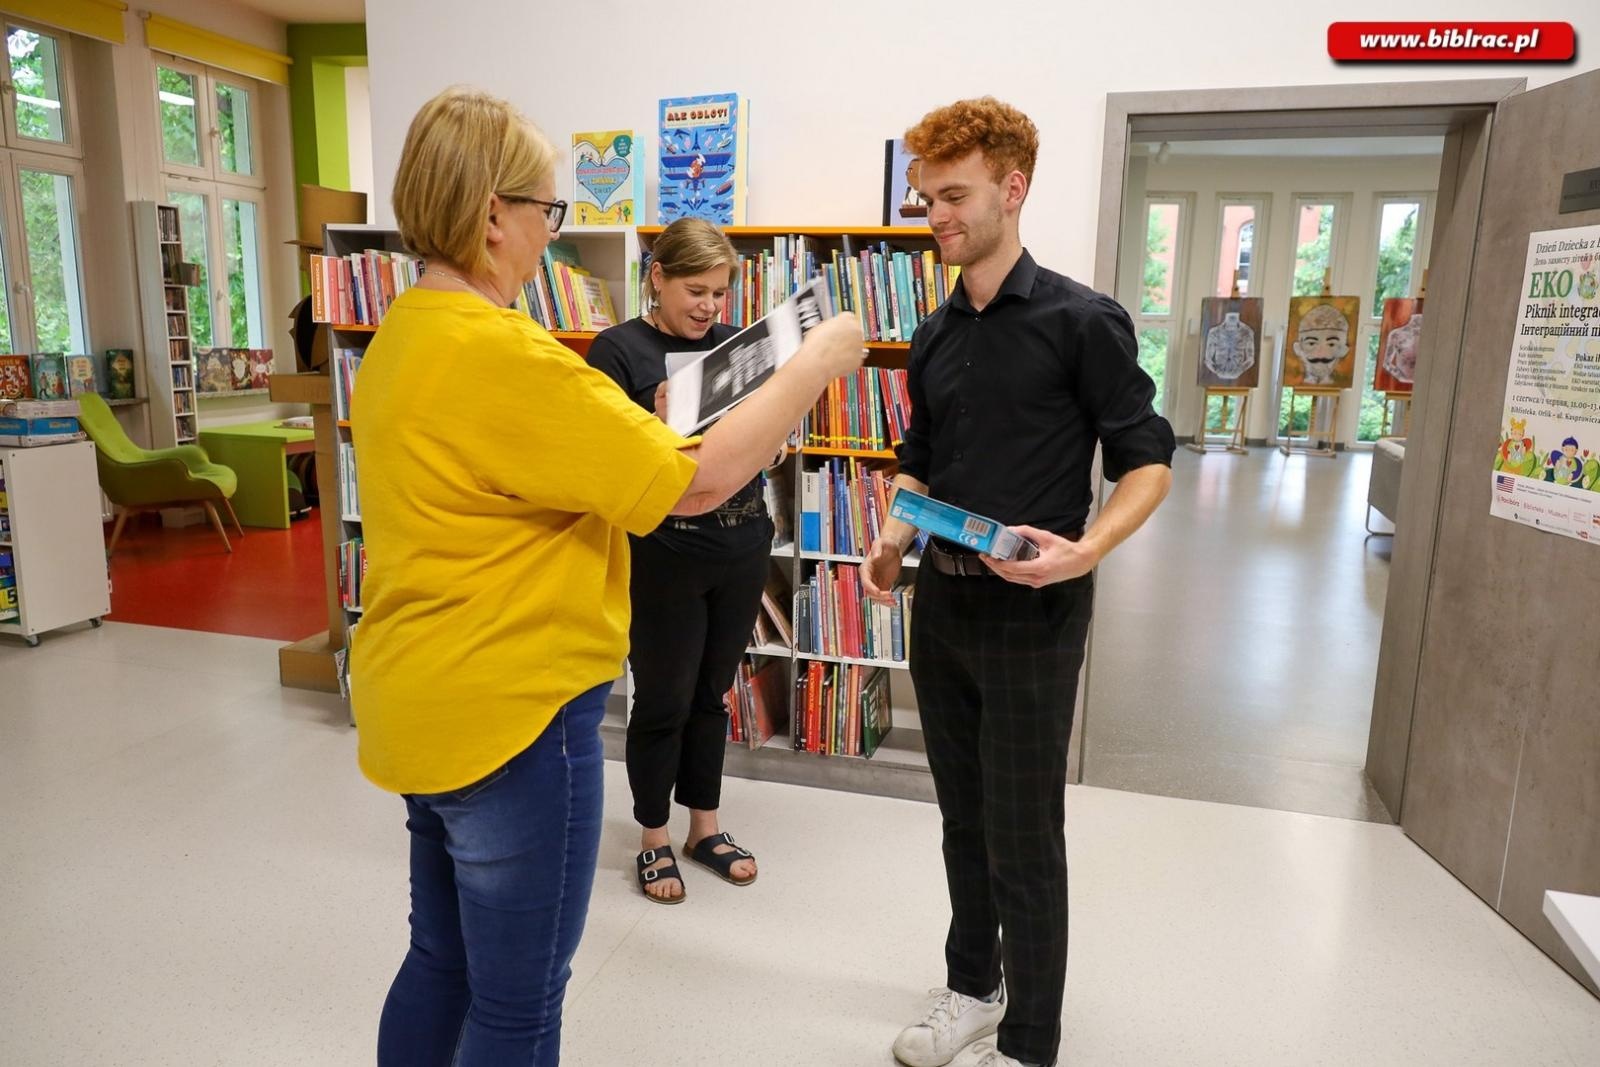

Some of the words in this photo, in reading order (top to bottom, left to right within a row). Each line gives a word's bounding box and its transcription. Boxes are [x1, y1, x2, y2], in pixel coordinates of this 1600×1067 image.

[667, 112, 688, 121] ALE
[1536, 240, 1557, 254] Dzień
[1558, 238, 1588, 251] Dziecka
[1590, 240, 1597, 249] z
[1529, 270, 1573, 298] EKO
[1525, 303, 1557, 318] Piknik
[1558, 303, 1600, 321] integra
[1520, 323, 1589, 338] Інтеграційний
